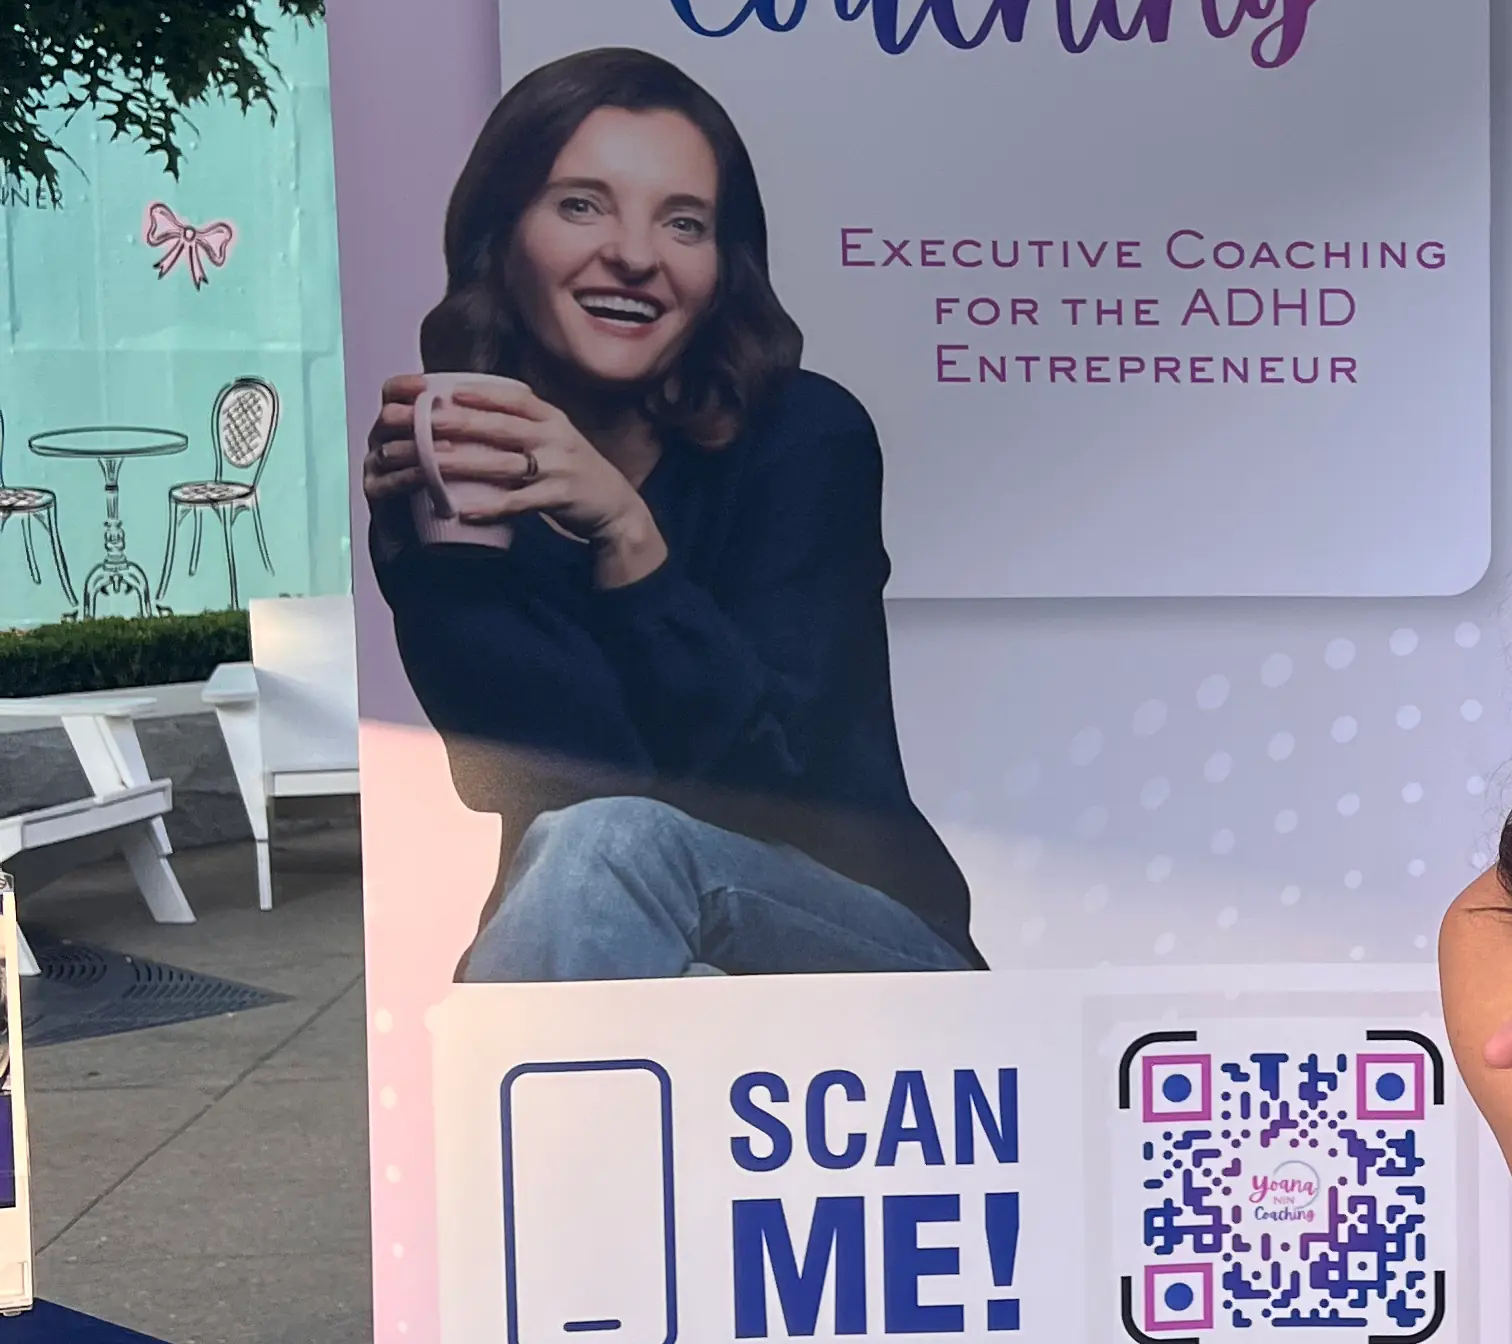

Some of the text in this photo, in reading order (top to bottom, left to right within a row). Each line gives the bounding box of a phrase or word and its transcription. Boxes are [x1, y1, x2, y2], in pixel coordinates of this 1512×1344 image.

[1180, 288, 1356, 327] ADHD
[729, 1067, 1020, 1173] SCAN
[1254, 1205, 1316, 1223] Coaching
[731, 1191, 1021, 1339] ME!
